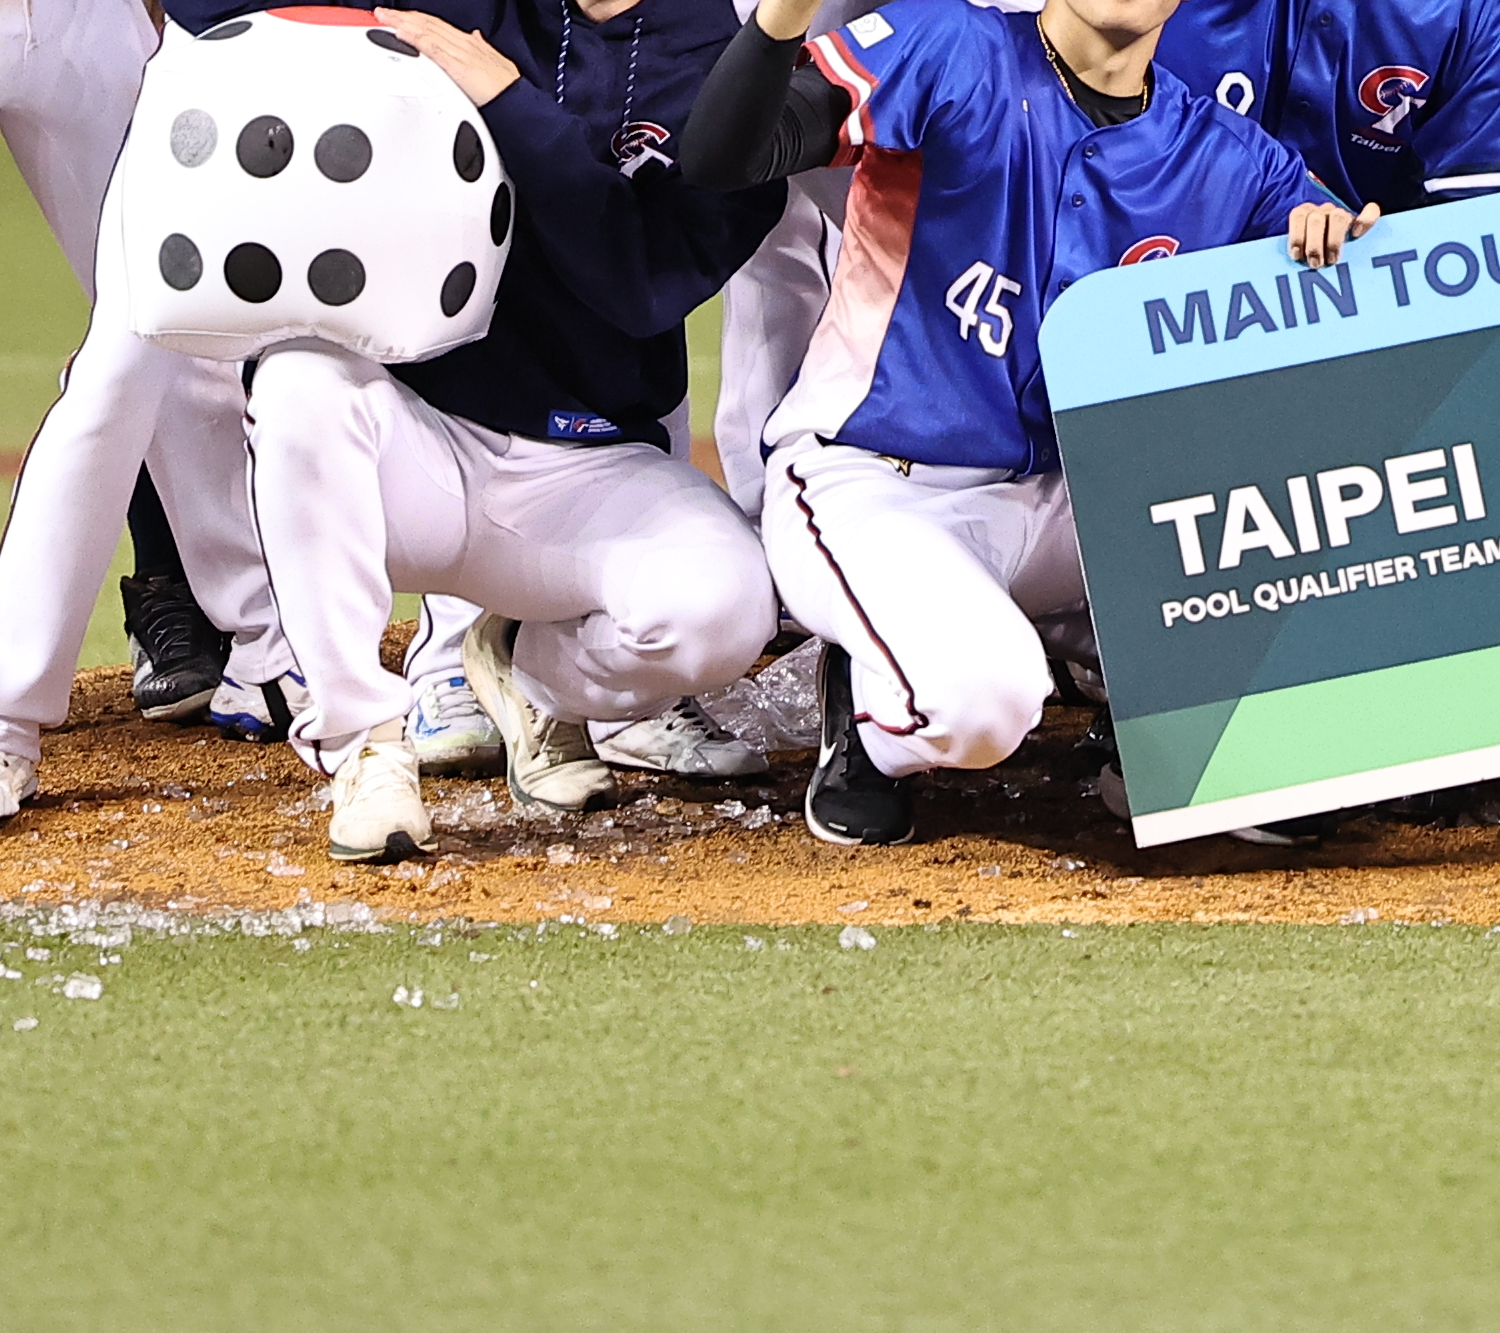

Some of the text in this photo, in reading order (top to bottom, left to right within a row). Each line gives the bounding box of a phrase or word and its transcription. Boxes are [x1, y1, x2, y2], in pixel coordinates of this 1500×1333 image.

[1351, 133, 1401, 153] Taipei
[945, 260, 1022, 358] 45
[1143, 261, 1358, 354] MAIN
[1150, 443, 1487, 578] TAIPEI
[1162, 591, 1251, 627] POOL
[1254, 556, 1418, 613] QUALIFIER
